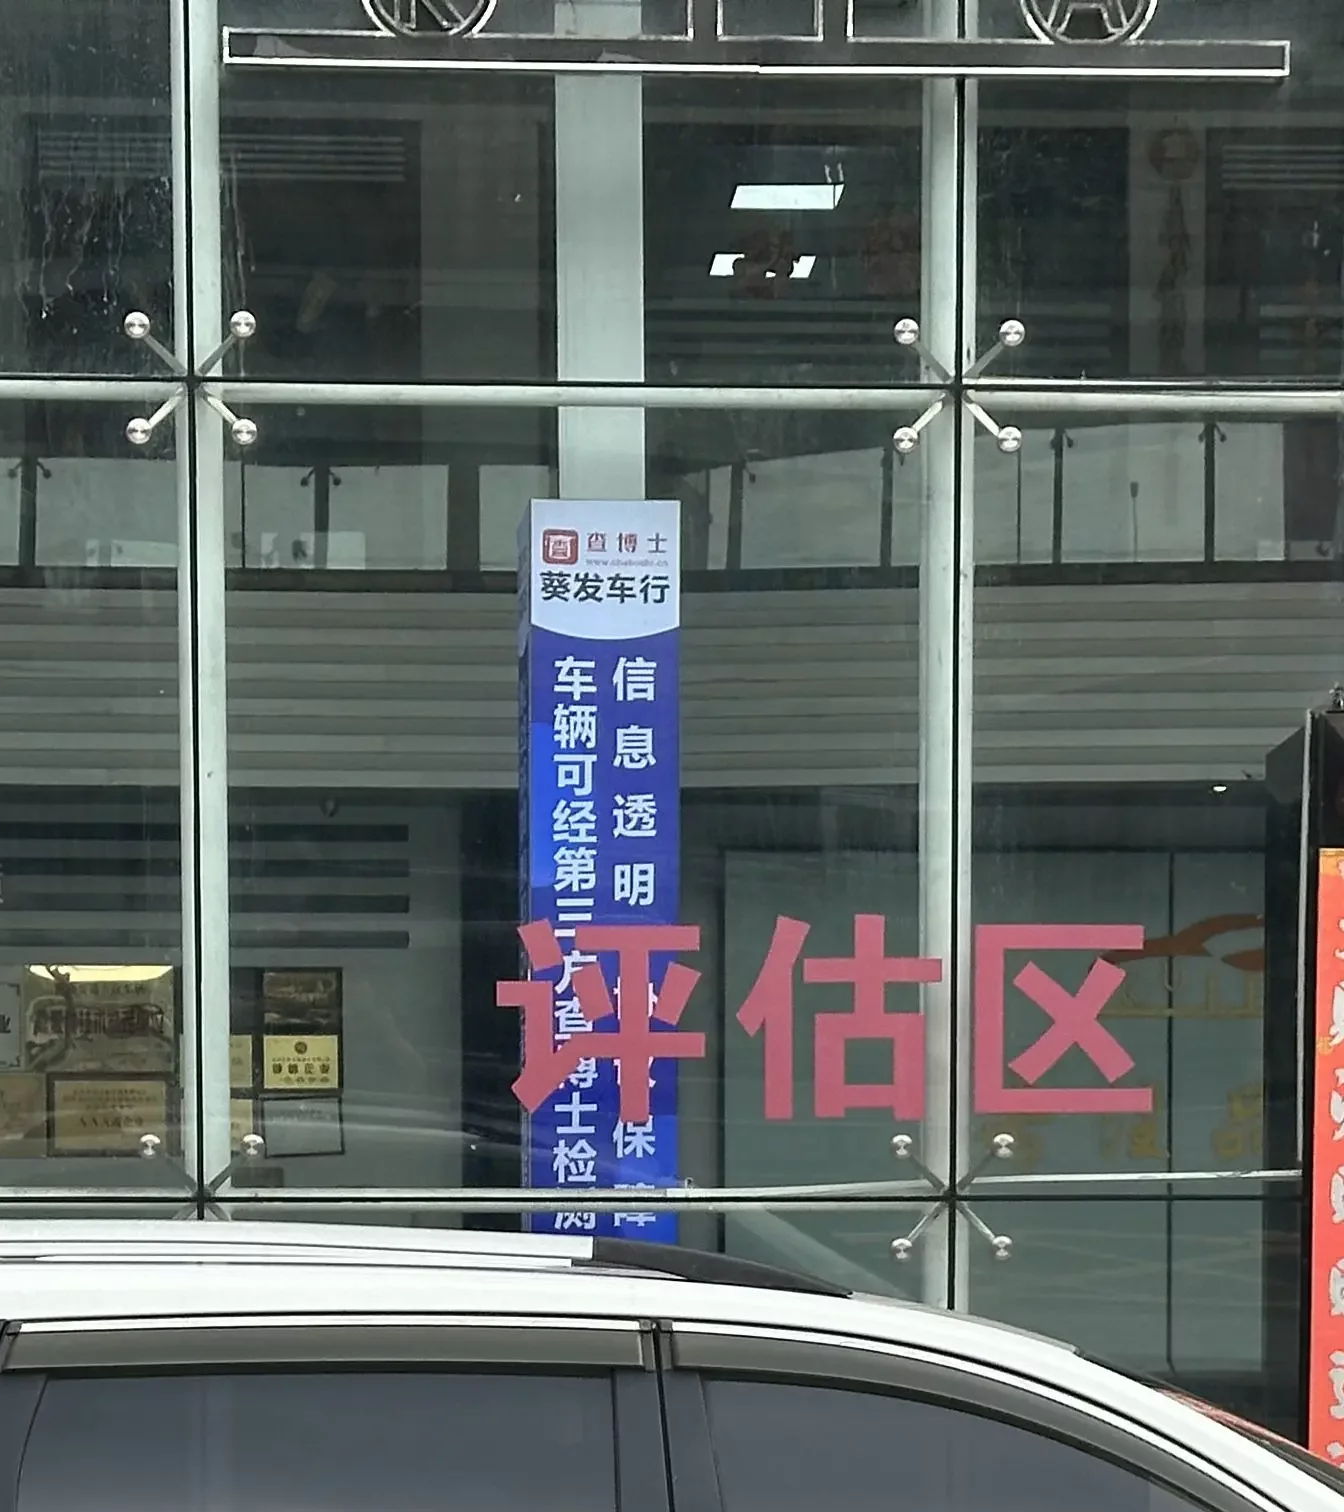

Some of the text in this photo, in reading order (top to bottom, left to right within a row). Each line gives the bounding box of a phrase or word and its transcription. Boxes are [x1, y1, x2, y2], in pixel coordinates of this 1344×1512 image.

[540, 570, 670, 604] 葵发车行
[495, 914, 1154, 1123] 评估区
